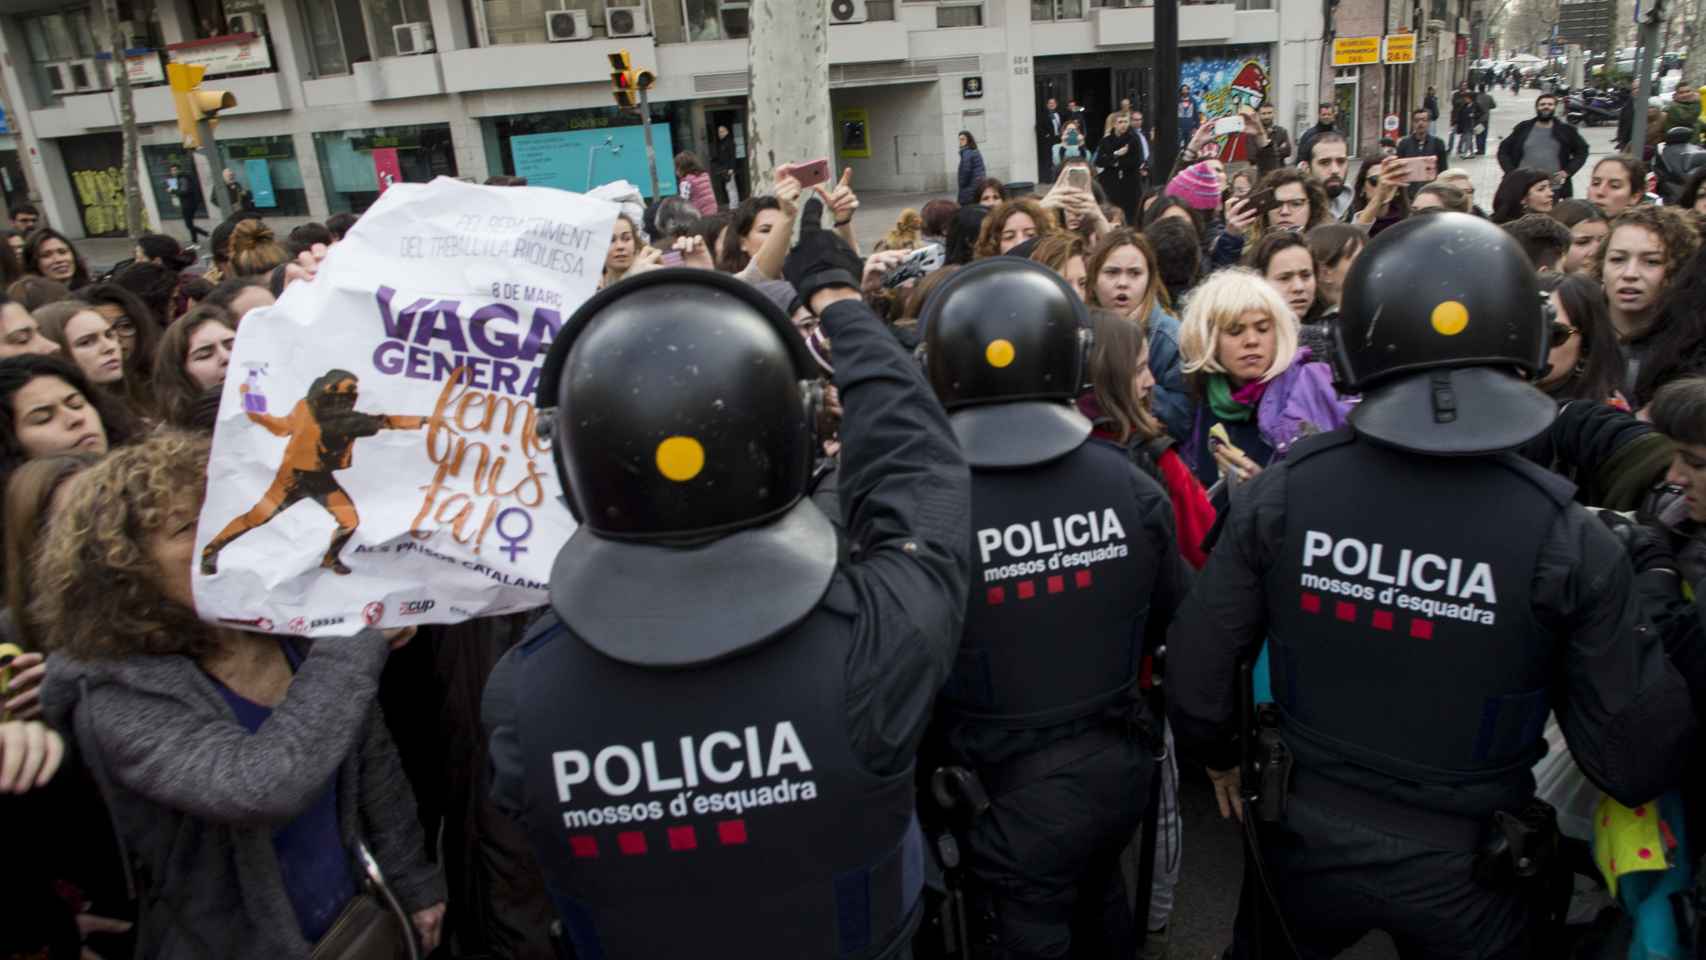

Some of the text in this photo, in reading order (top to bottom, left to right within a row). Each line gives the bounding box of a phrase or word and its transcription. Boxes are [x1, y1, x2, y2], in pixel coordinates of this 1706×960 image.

[512, 237, 585, 276] RIQUESA
[491, 281, 501, 298] 8
[504, 283, 521, 300] DE
[376, 284, 562, 362] VAGA
[977, 508, 1126, 563] POLICIA
[461, 560, 551, 590] CATALANS
[984, 558, 1046, 582] mossos
[1302, 530, 1497, 604] POLICIA
[1300, 572, 1375, 600] mossos
[409, 599, 435, 612] cup
[552, 720, 812, 803] POLICIA
[562, 800, 664, 828] mossos
